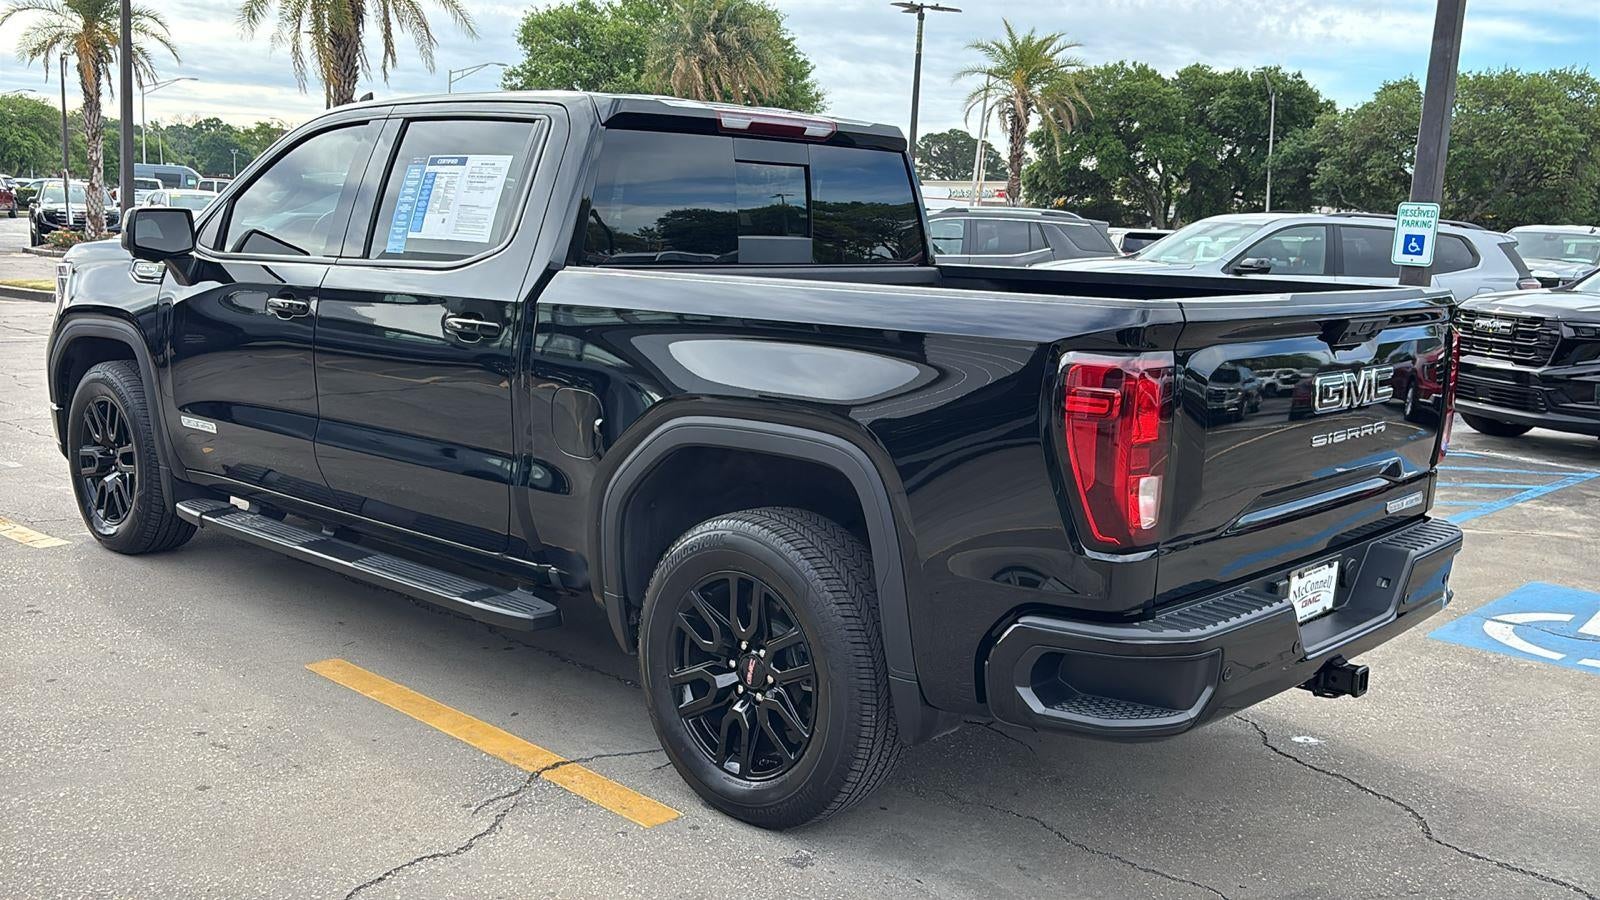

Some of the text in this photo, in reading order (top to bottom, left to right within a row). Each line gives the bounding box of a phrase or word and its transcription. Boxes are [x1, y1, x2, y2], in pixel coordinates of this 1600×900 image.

[1400, 209, 1436, 218] RESERVED
[1401, 219, 1432, 229] PARKING
[1311, 365, 1394, 414] GMC
[1311, 421, 1387, 448] SIERRA
[1292, 575, 1333, 602] McConnell
[1301, 593, 1322, 608] GMC
